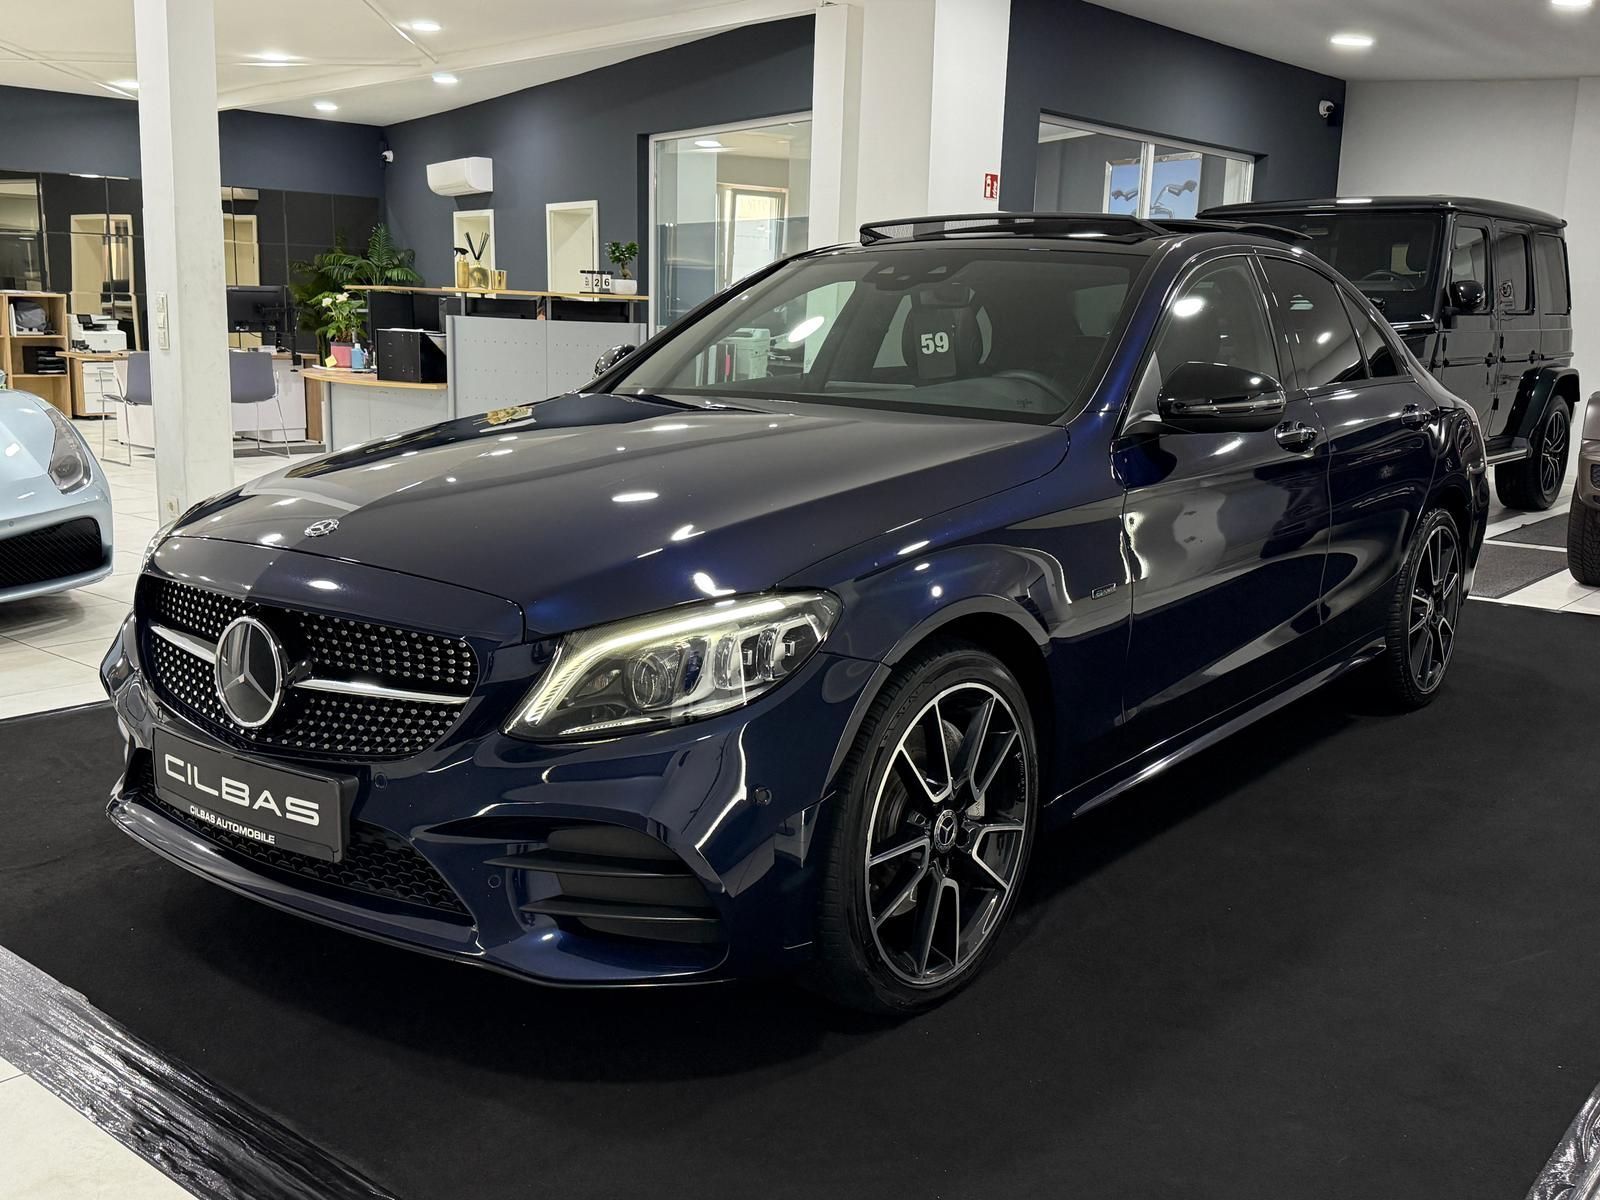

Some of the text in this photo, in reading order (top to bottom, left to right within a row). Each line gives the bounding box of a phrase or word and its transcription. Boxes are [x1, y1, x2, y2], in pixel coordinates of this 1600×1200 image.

[921, 331, 949, 354] 59
[164, 753, 320, 826] CILBAS
[189, 805, 275, 844] CILBAS AUTOMOBILE
